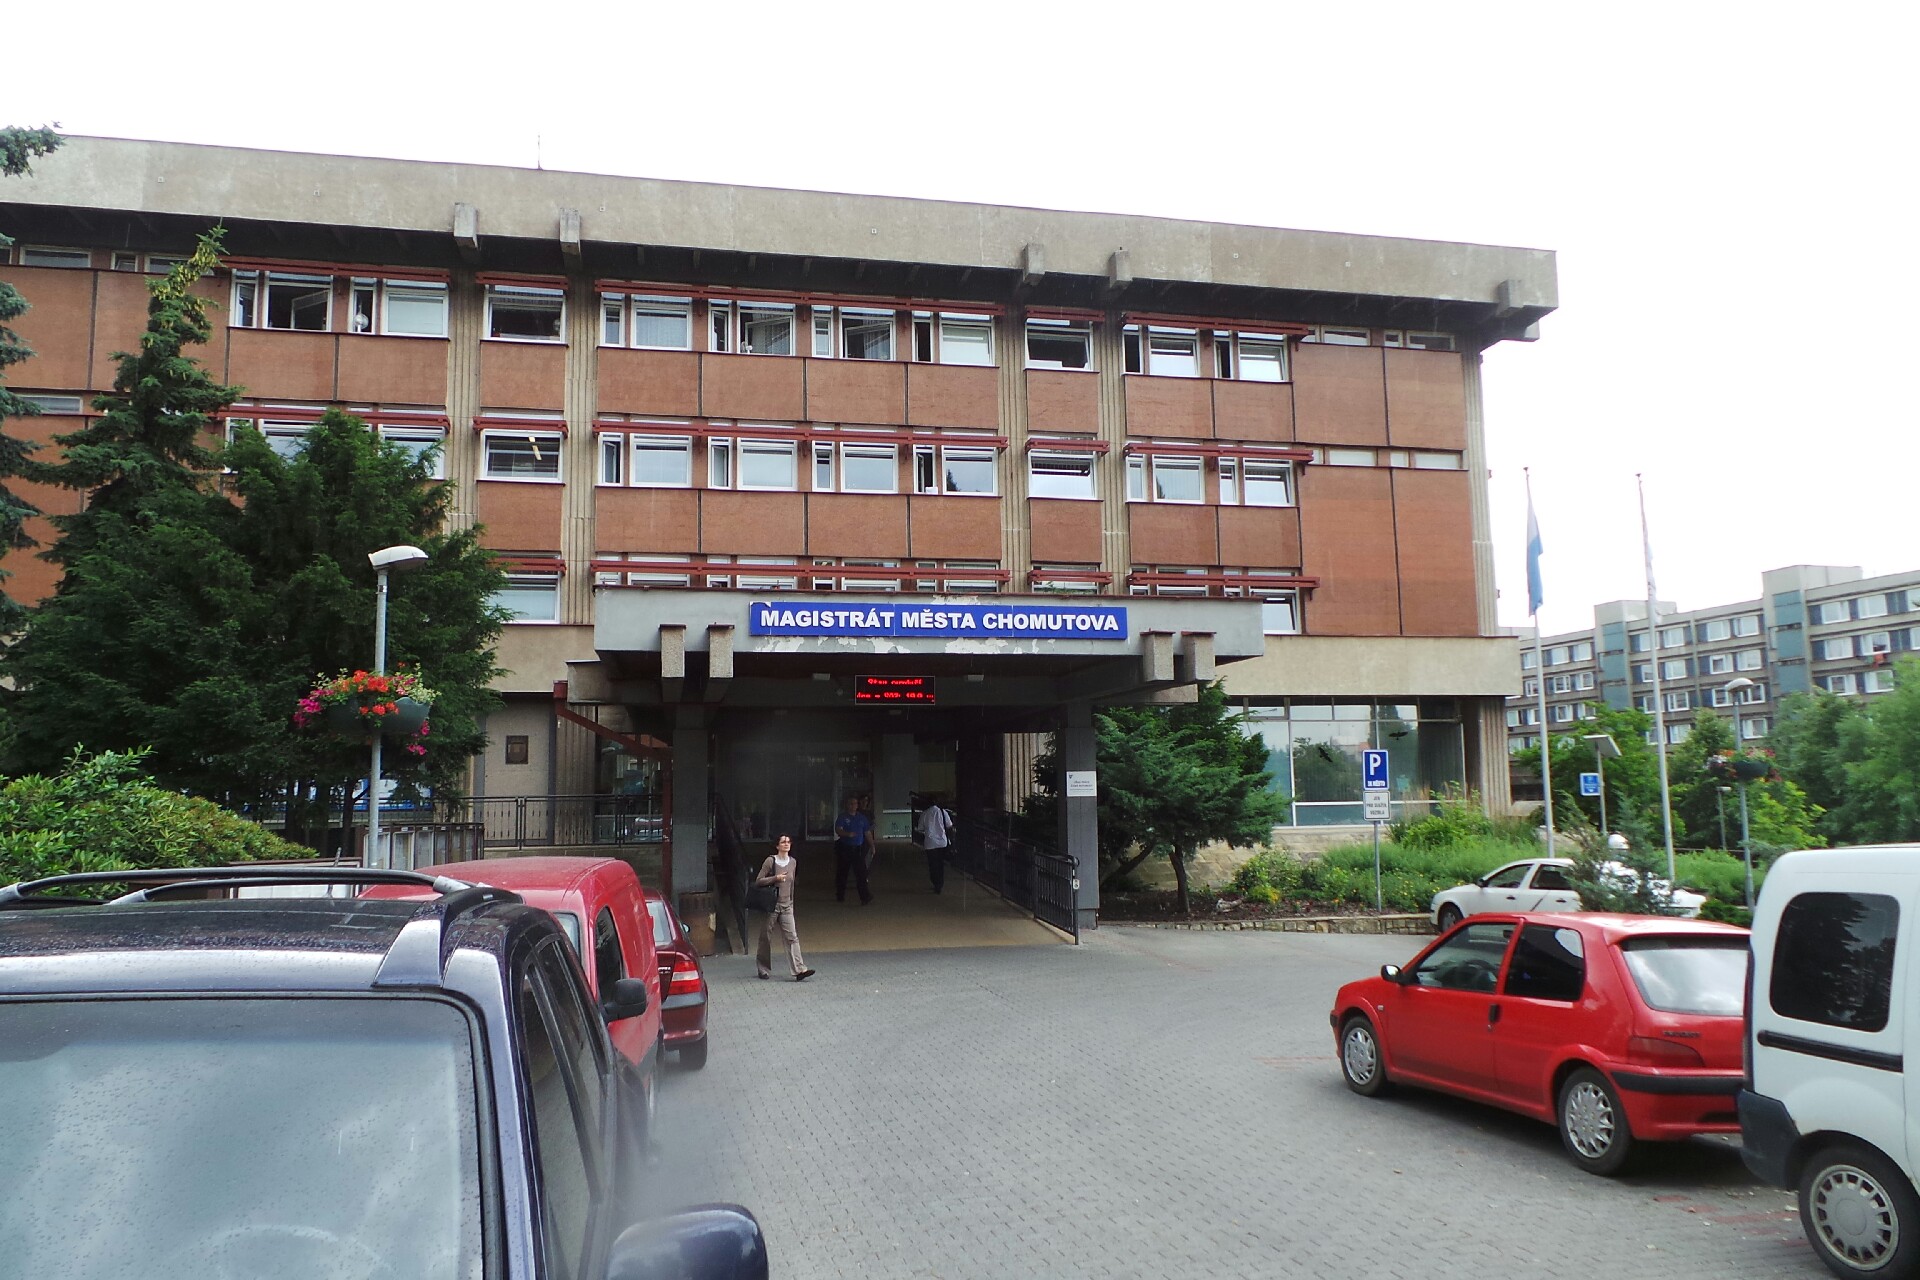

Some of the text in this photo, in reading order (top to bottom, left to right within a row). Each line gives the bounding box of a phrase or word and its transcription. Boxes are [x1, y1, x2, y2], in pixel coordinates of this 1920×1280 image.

[760, 607, 1119, 631] MAGISTRÁT MĚSTA CHOMUTOVA
[1369, 753, 1381, 775] P
